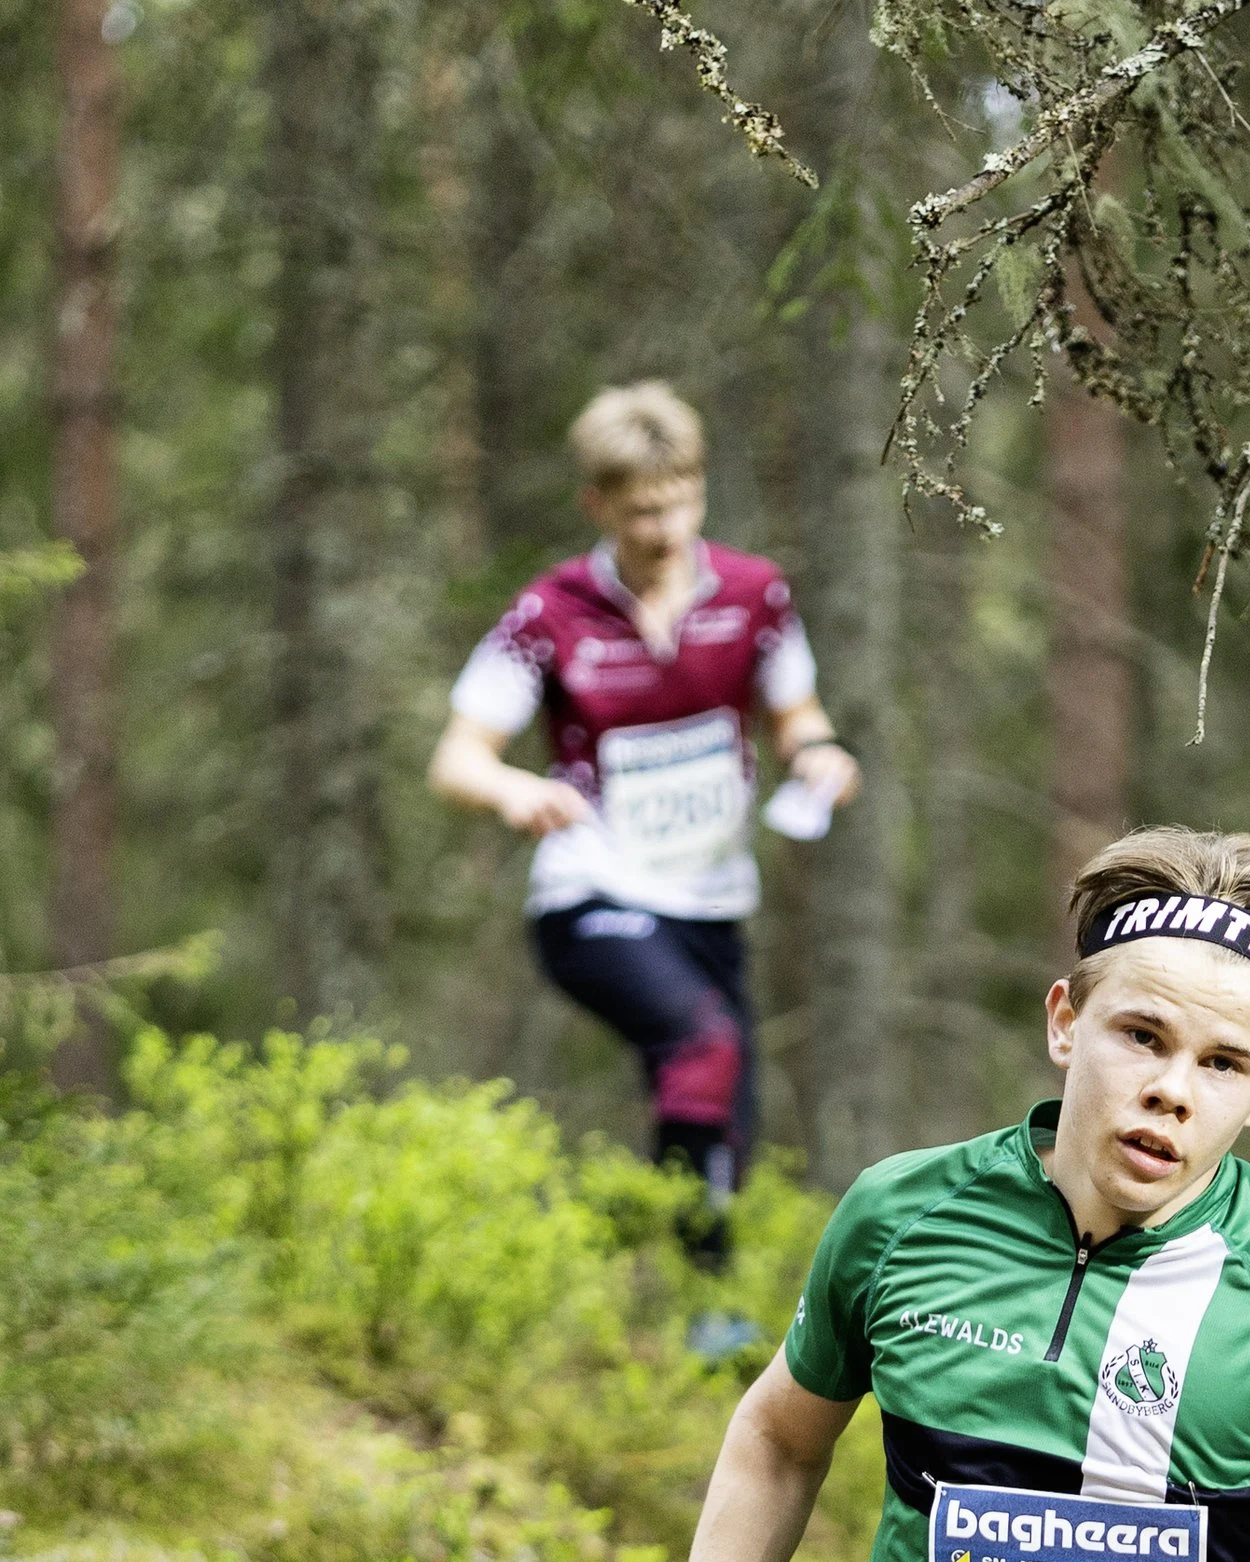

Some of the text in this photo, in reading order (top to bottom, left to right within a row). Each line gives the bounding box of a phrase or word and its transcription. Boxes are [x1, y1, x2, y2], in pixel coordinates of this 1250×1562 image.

[900, 1310, 1024, 1354] ALEWALDS
[1102, 1382, 1174, 1416] SUNDBYBERG
[946, 1500, 1190, 1557] bagheera
